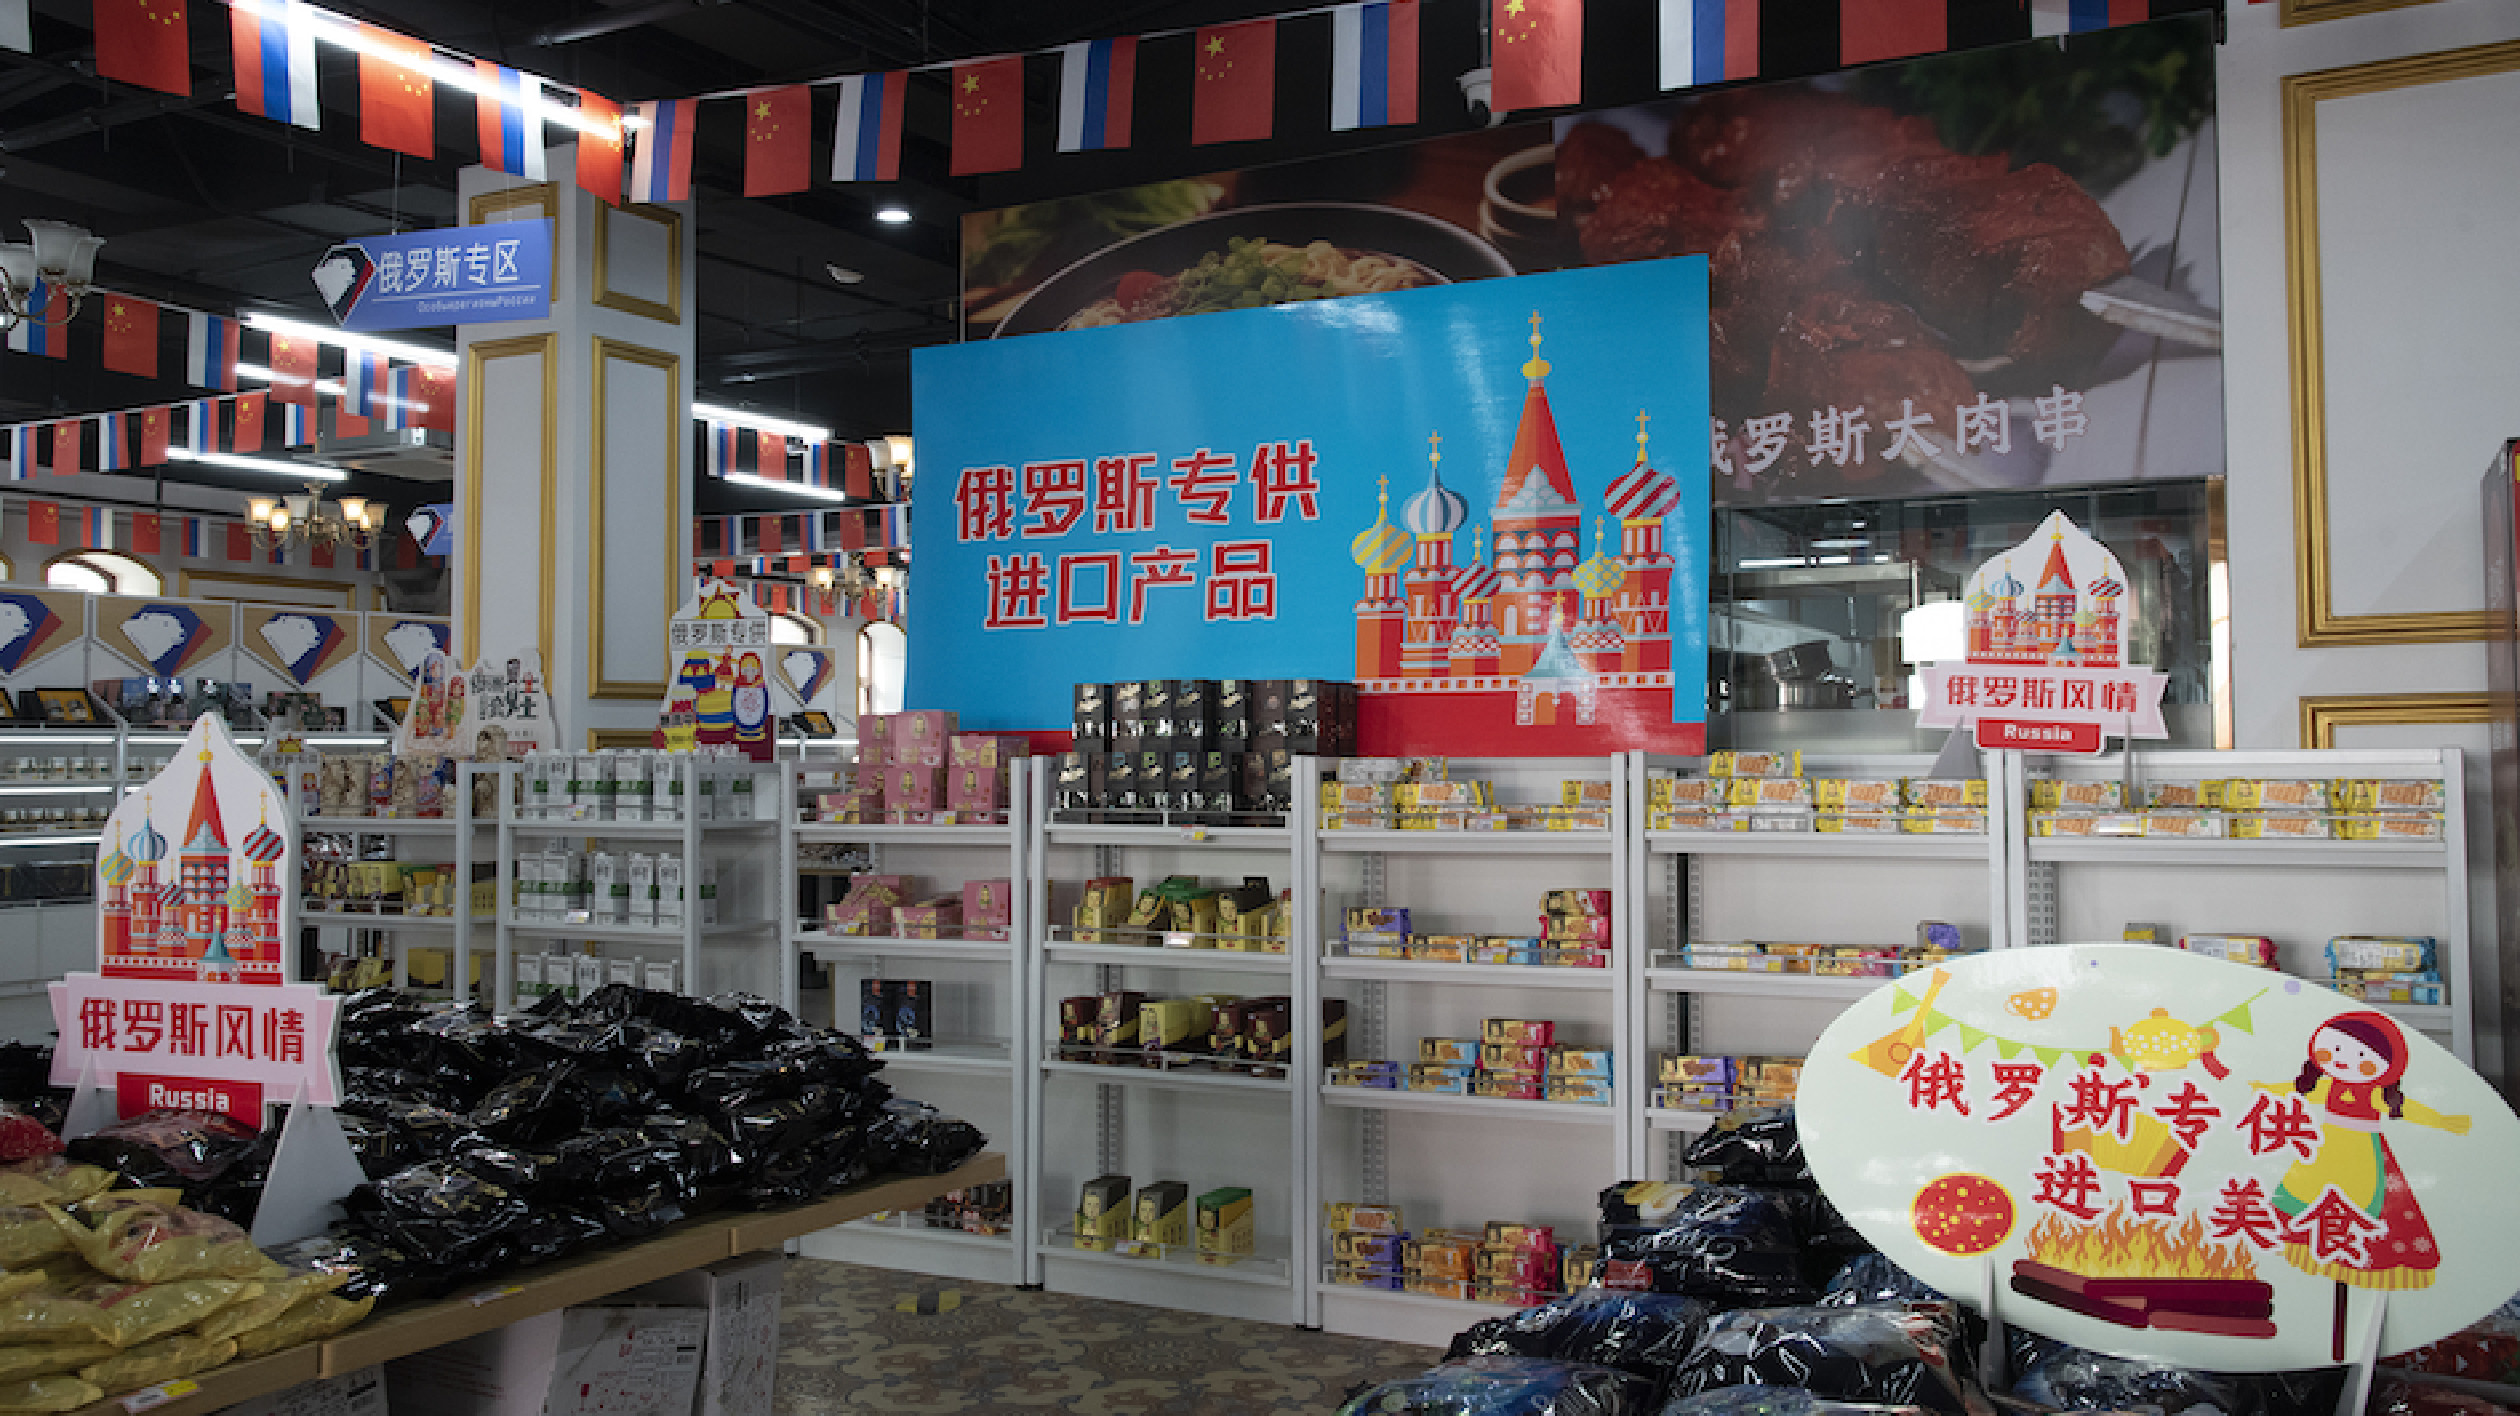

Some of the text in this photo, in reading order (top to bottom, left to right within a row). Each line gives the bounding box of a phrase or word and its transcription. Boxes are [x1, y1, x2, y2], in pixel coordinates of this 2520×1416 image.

[377, 240, 521, 293] 俄罗斯专区
[956, 440, 1319, 541] 俄罗斯专供
[984, 540, 1277, 629] 进口产品
[1947, 675, 2139, 713] 俄罗斯风情
[2004, 724, 2075, 743] Russia
[80, 997, 305, 1064] 俄罗斯风情
[150, 1083, 230, 1112] Russia
[1899, 1052, 2321, 1158] 俄罗斯专供
[2033, 1157, 2378, 1268] 进口美食
